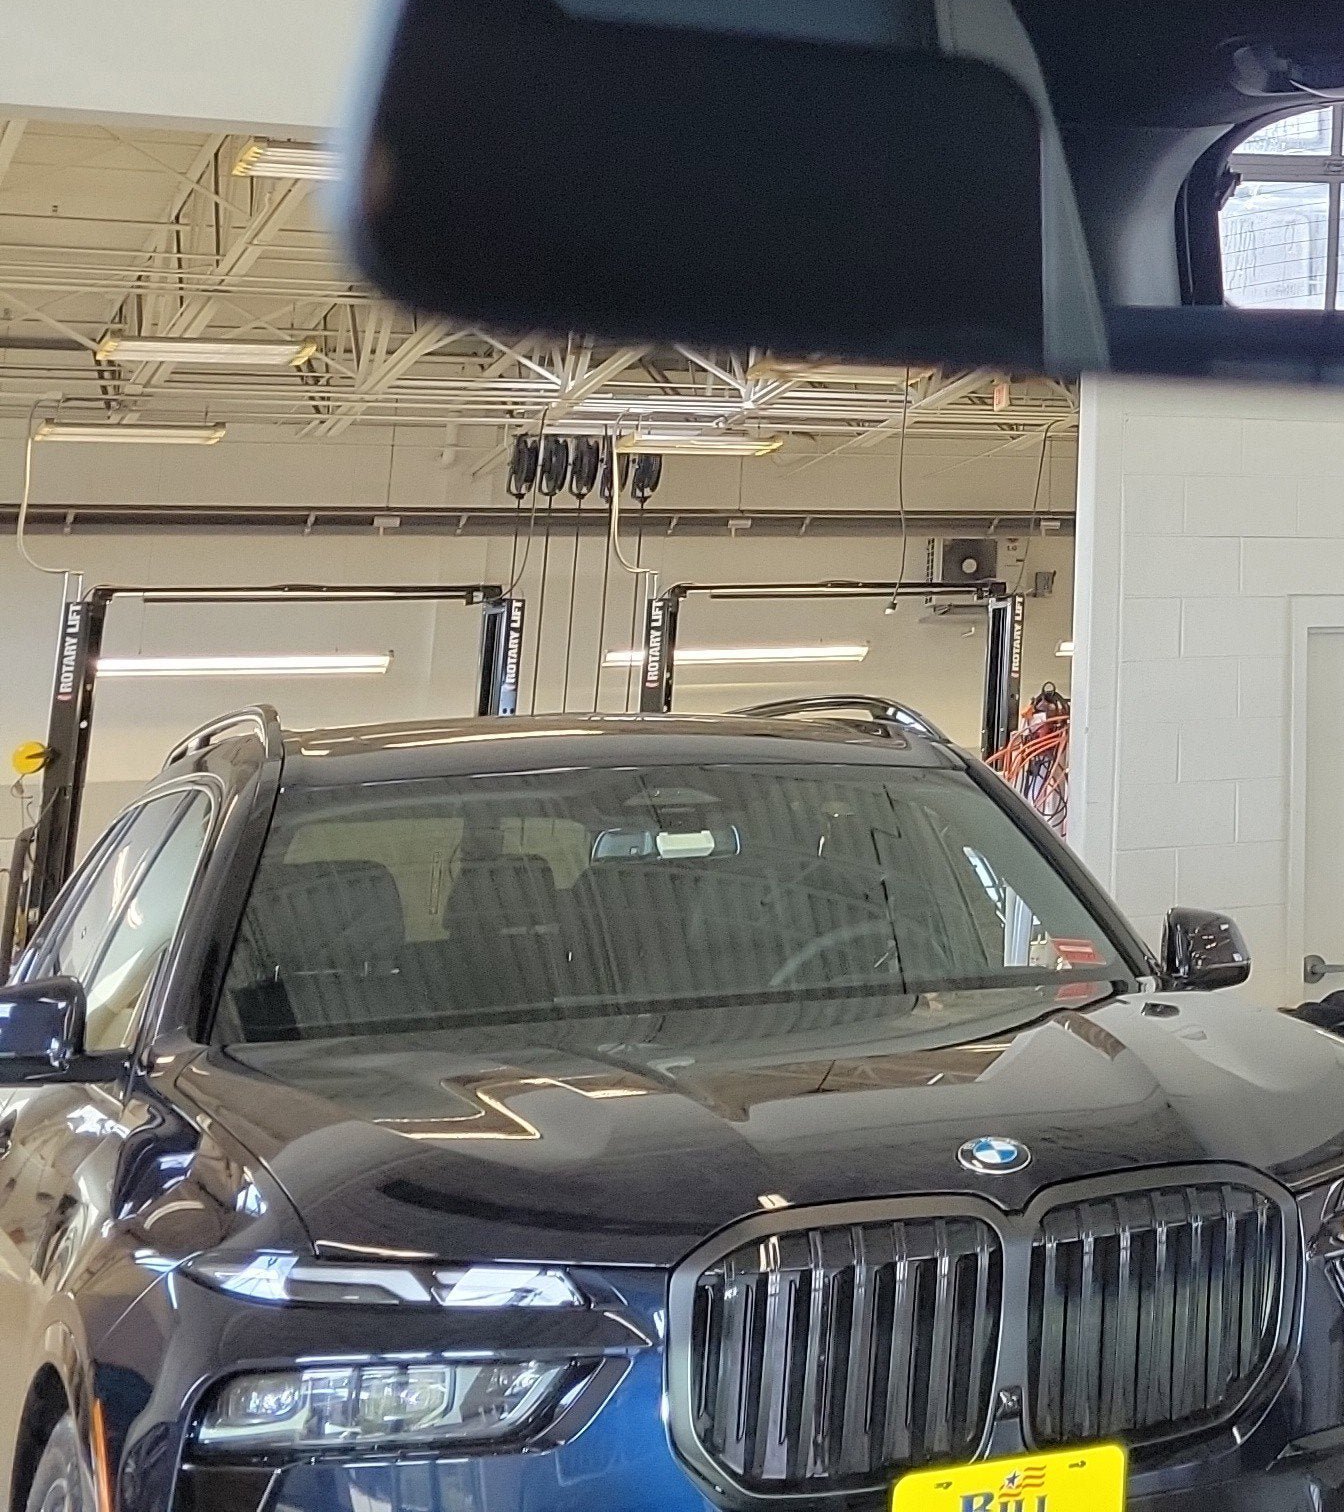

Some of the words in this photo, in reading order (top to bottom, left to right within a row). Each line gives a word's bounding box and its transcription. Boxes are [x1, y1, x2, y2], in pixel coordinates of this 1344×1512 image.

[66, 603, 82, 633] LIFT
[510, 600, 523, 628] LIFT
[651, 600, 664, 627] LIFT
[1014, 595, 1023, 621] LIFT
[59, 636, 78, 693] ROTARY
[505, 630, 520, 683] ROTARY
[647, 629, 662, 681] ROTARY
[1012, 623, 1022, 671] ROTARY
